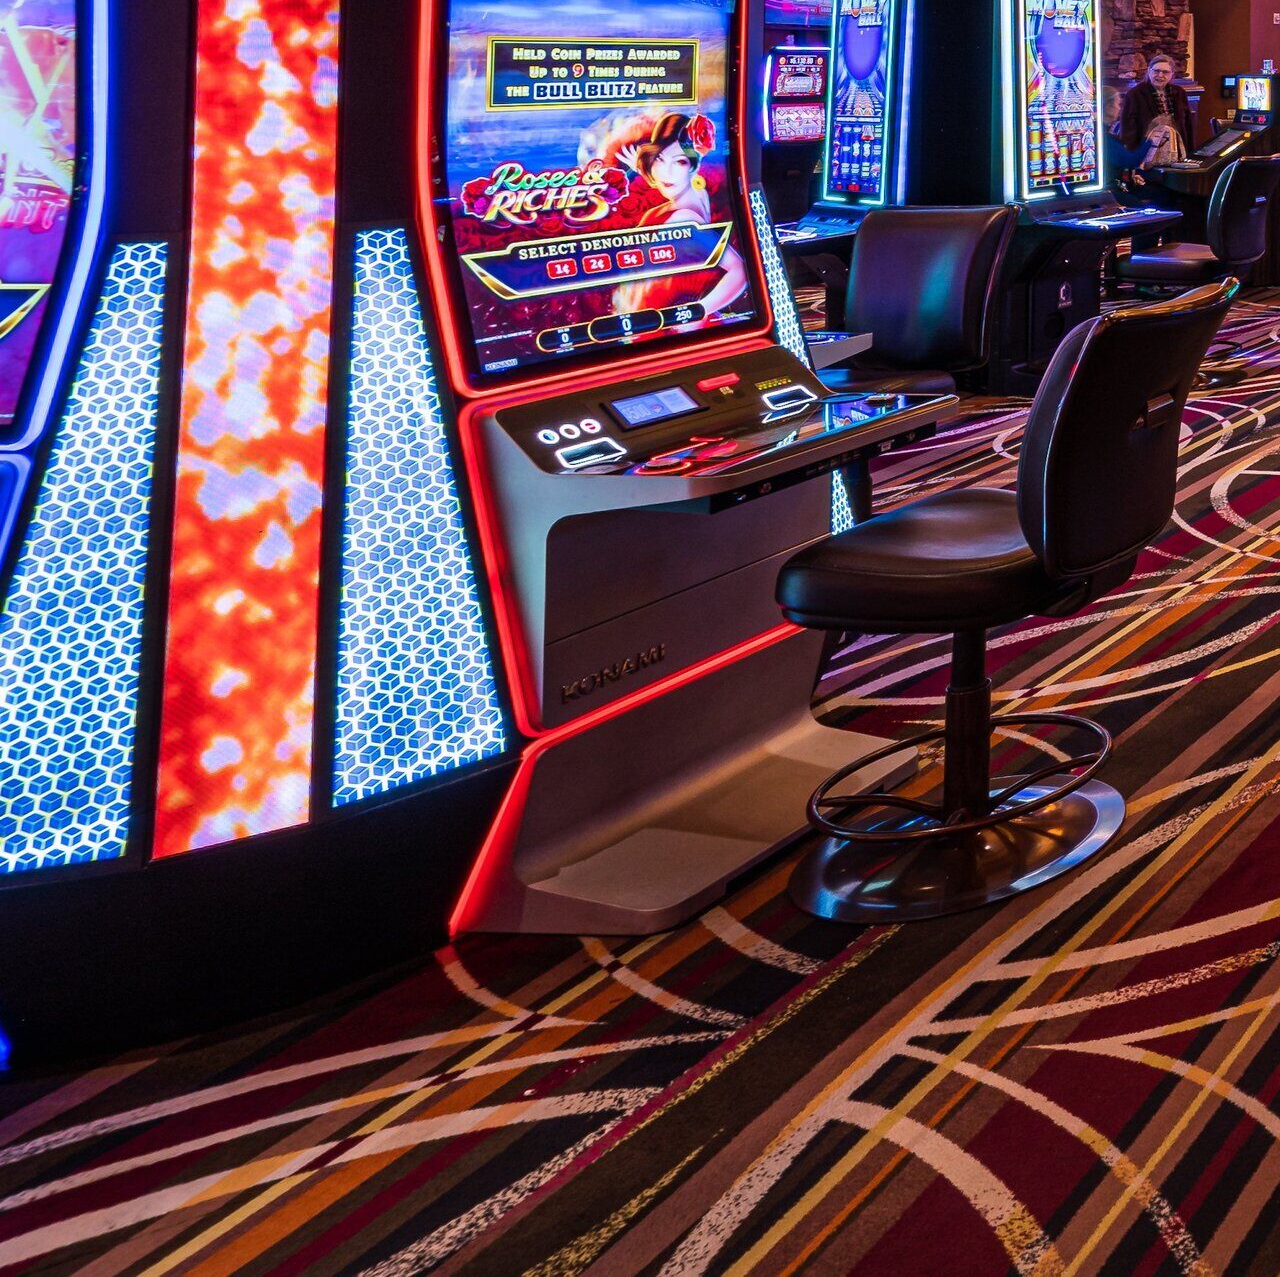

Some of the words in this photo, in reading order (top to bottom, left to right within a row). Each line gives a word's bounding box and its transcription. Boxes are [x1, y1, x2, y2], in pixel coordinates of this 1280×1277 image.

[512, 48, 546, 61] HELD
[551, 48, 582, 61] COIN
[529, 66, 548, 79] UP
[552, 66, 568, 78] TO
[572, 63, 585, 78] 9
[588, 66, 619, 78] TIMES
[624, 65, 666, 77] DURING
[506, 85, 530, 97] THE
[535, 84, 581, 99] BULL
[587, 82, 634, 98] BLITZ
[638, 82, 684, 94] FEATURE
[485, 163, 580, 195] Roses
[483, 183, 610, 225] RICHES
[519, 243, 577, 261] SELECT
[582, 228, 692, 252] DENOMINATION
[555, 264, 570, 275] 1¢
[590, 260, 605, 270] 2¢
[624, 254, 638, 265] 5¢
[653, 250, 672, 260] 10¢
[675, 310, 693, 321] 250
[622, 318, 632, 331] 0
[561, 333, 569, 343] 0
[560, 643, 667, 705] KONAMI
